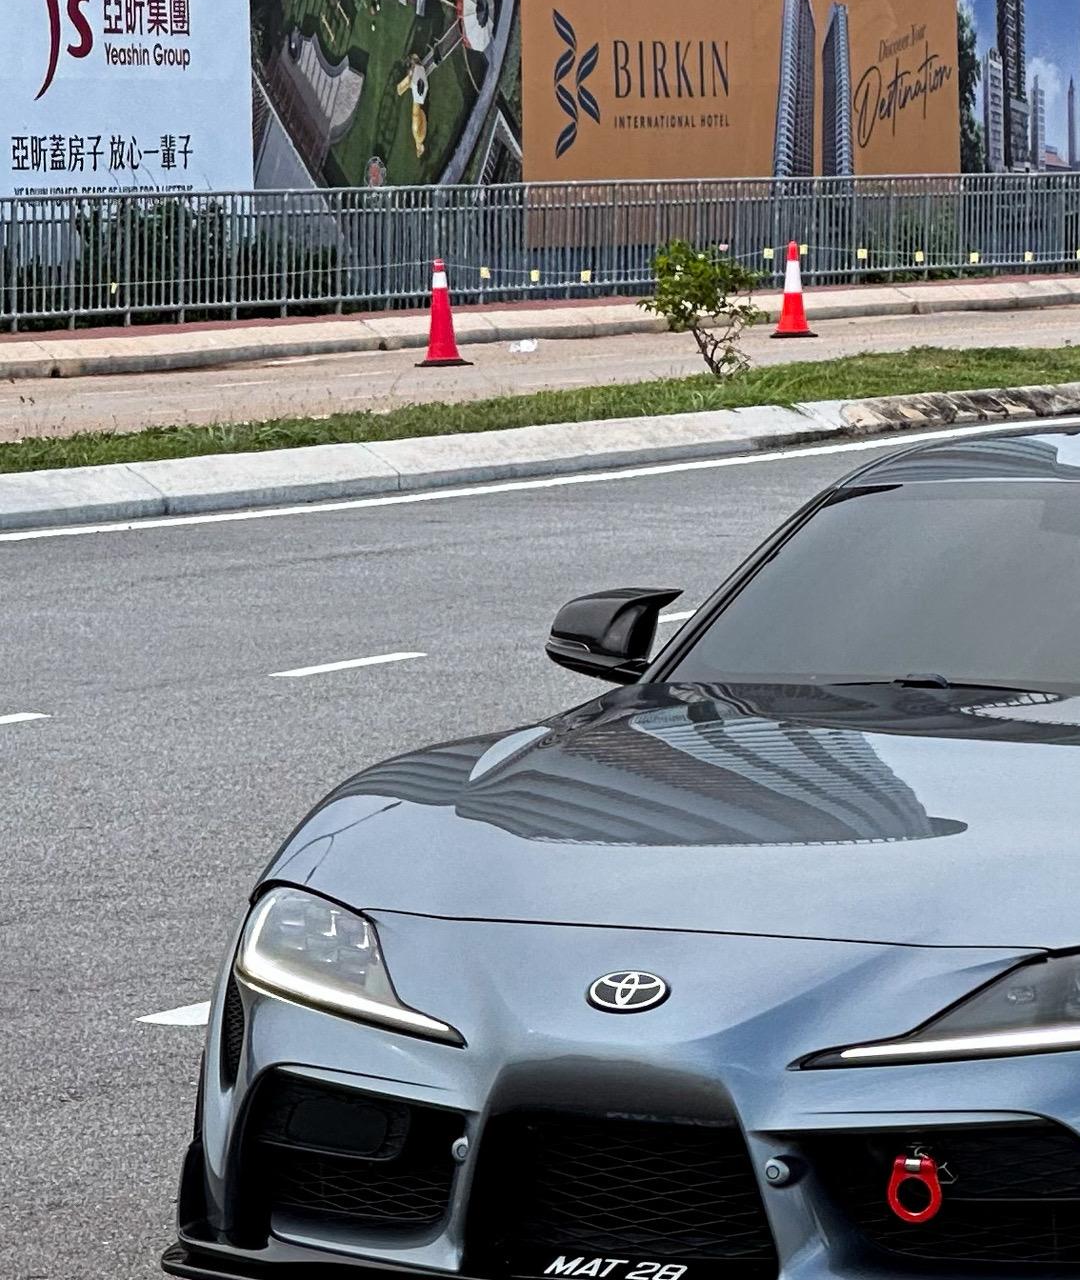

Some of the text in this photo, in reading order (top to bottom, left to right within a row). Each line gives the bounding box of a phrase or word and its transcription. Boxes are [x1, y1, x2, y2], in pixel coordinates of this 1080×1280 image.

[104, 42, 191, 71] Yeashin Group
[613, 40, 729, 98] BIRKIN
[853, 40, 952, 149] Destination
[614, 113, 730, 129] INTERNATIONAL HOTEL
[11, 134, 194, 172] 亞昕蓋房子 放心一輩子
[543, 1255, 630, 1278] MAT
